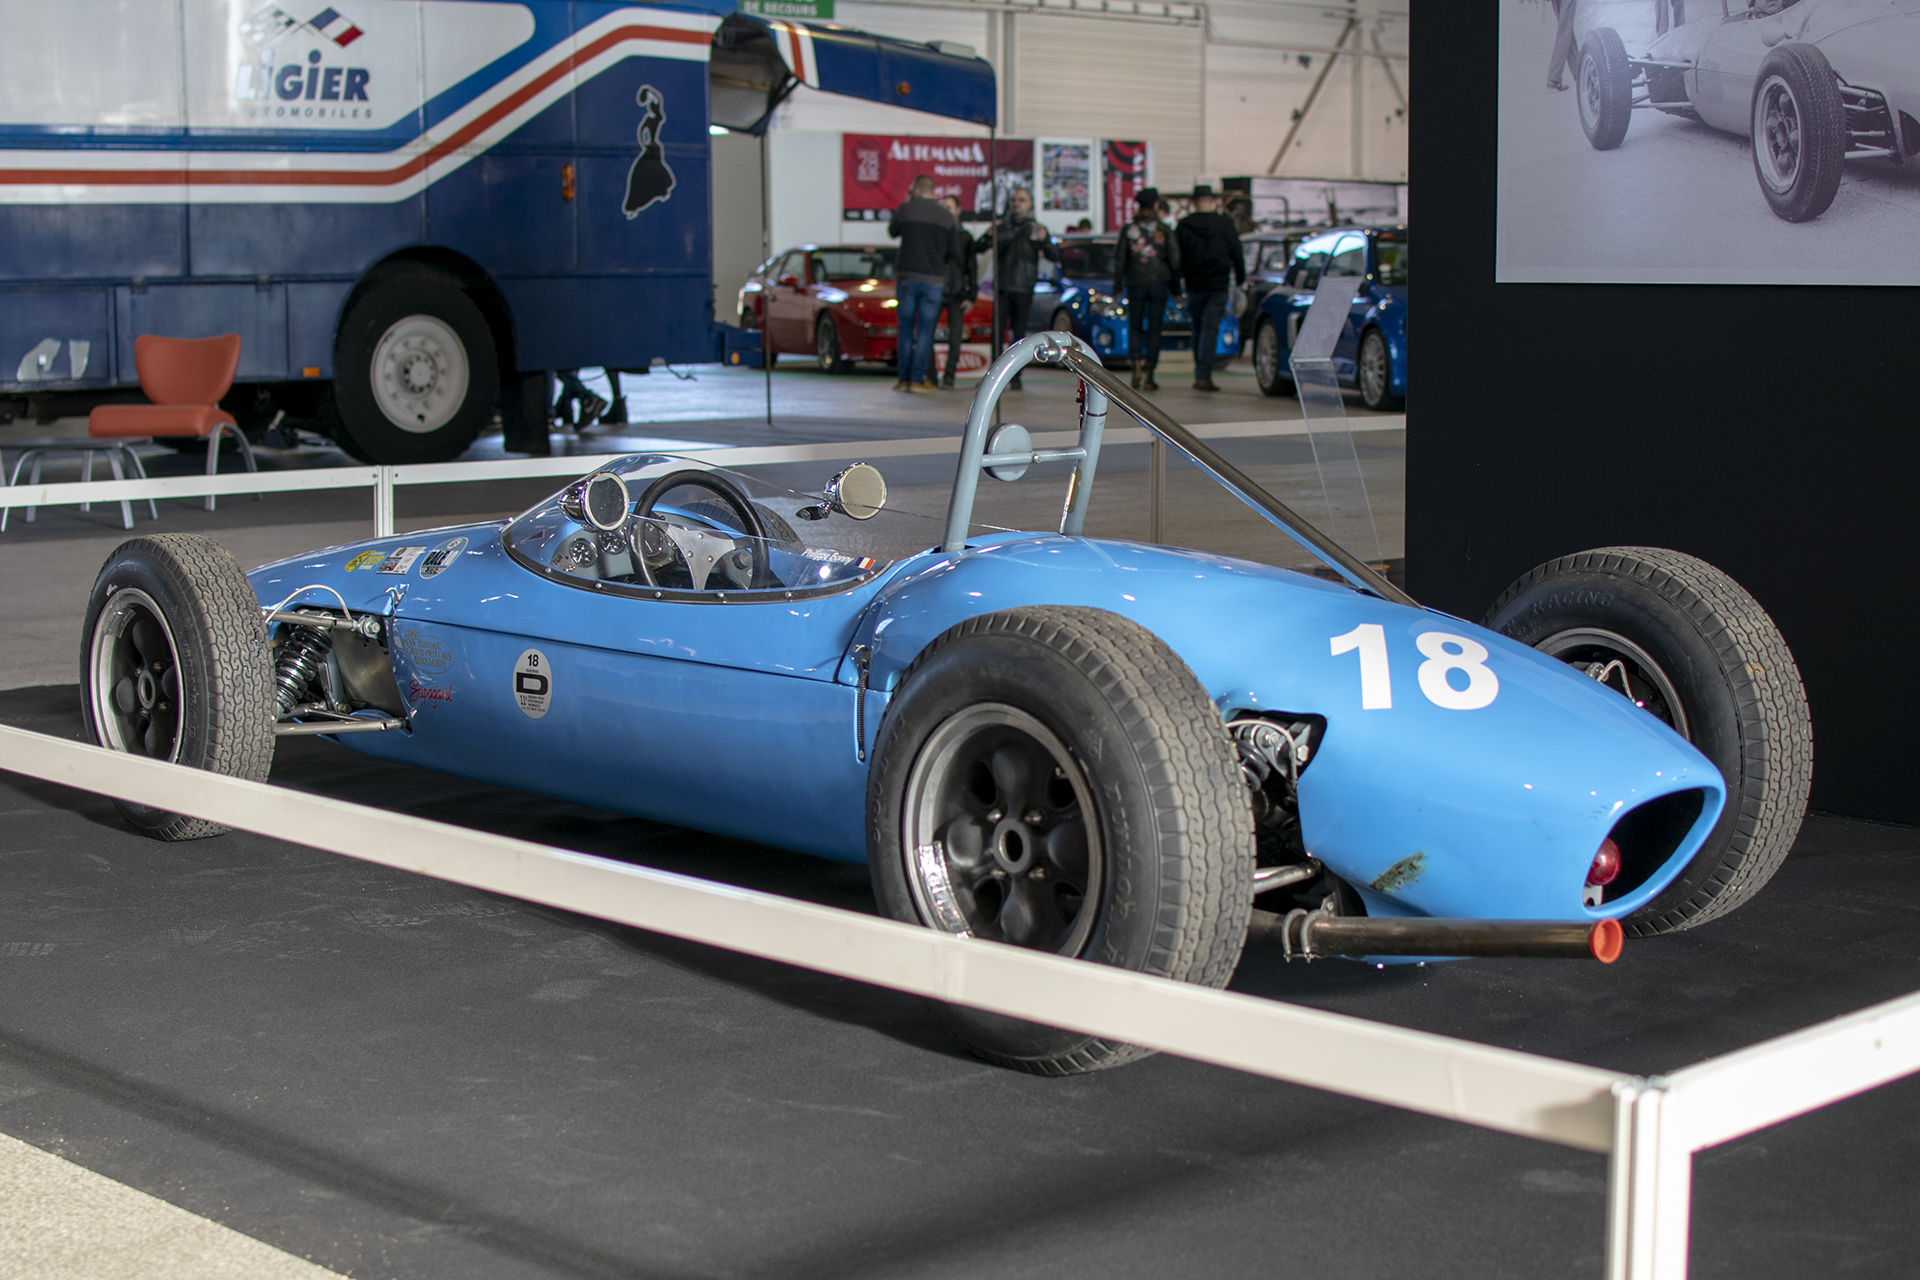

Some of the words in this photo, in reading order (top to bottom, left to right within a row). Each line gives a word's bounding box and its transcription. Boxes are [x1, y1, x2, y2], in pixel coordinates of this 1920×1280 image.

[763, 2, 818, 16] SECOURS
[417, 639, 442, 651] HISTORIC
[406, 646, 425, 656] GRAND
[425, 650, 438, 658] PRIX
[438, 651, 452, 661] CARS
[527, 653, 539, 667] 18
[413, 656, 446, 669] ASSOCIATION
[1329, 622, 1500, 711] 18
[516, 672, 548, 695] D
[408, 678, 453, 709] Supagard
